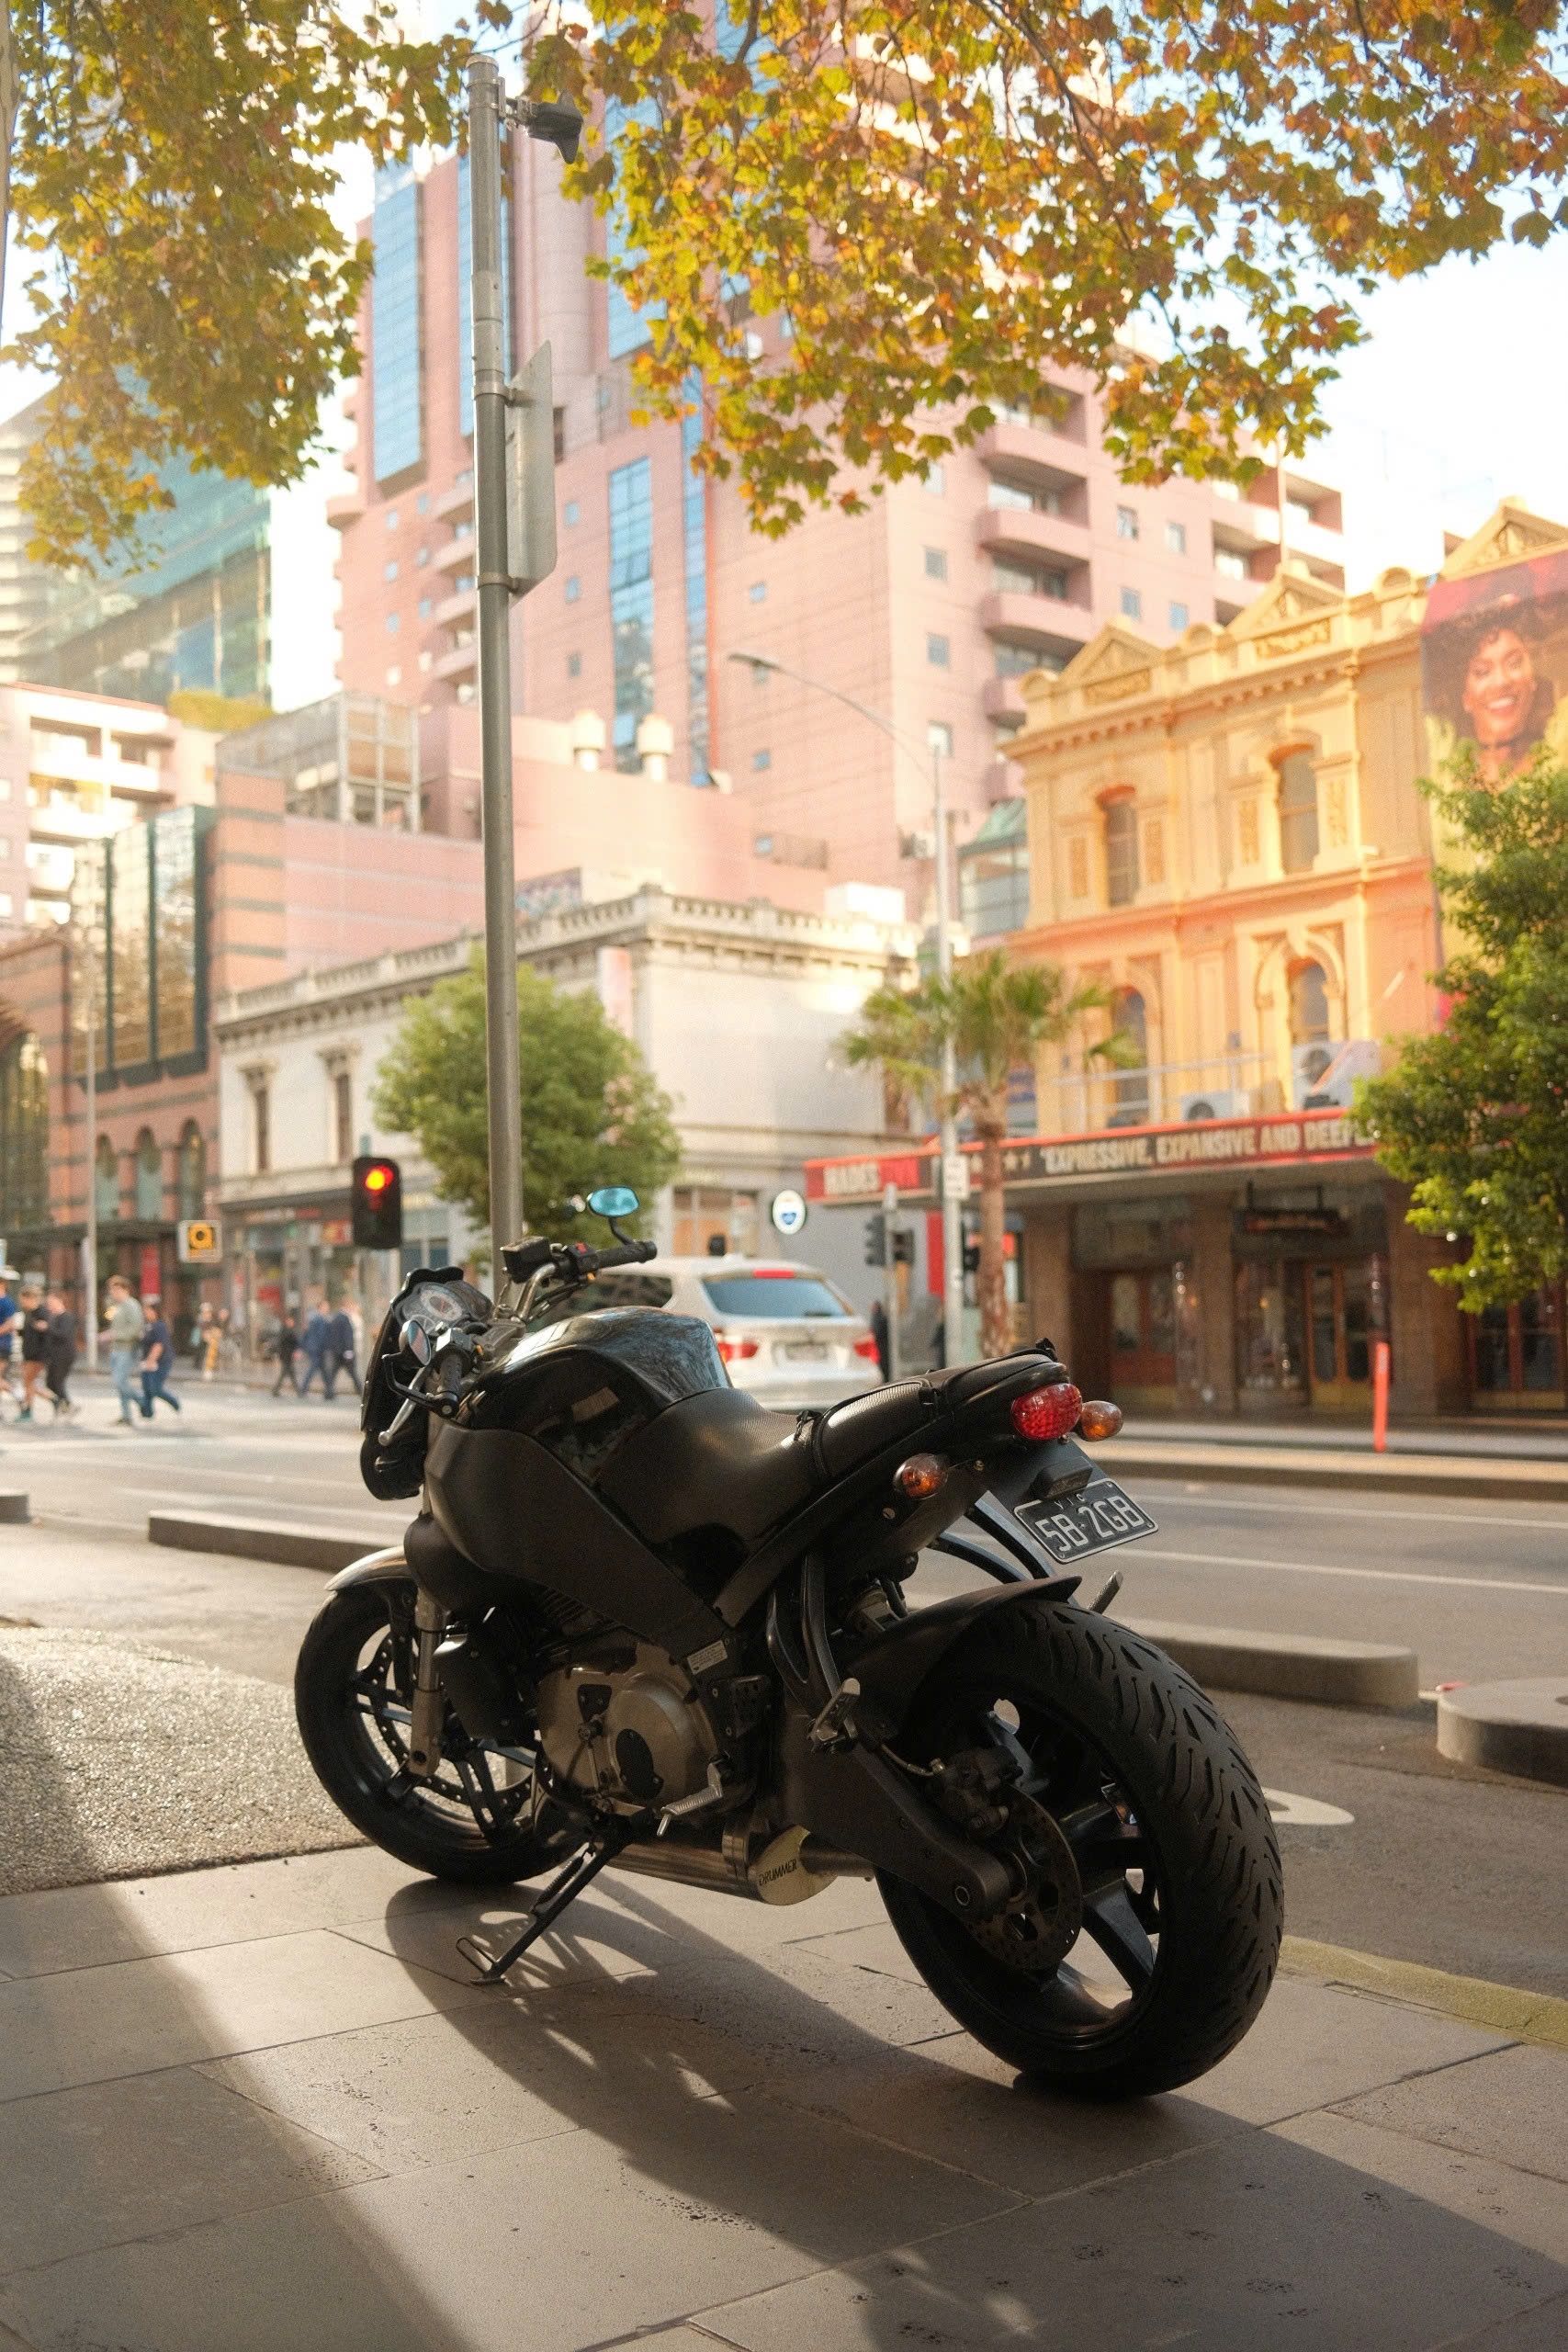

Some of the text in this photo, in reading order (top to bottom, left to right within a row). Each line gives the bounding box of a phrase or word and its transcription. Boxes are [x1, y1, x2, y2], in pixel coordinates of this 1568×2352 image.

[1156, 1127, 1256, 1164] EXPANSIVE
[1259, 1122, 1301, 1153] AND
[1054, 1493, 1086, 1510] VIC
[758, 1858, 797, 1886] DRUMMER
